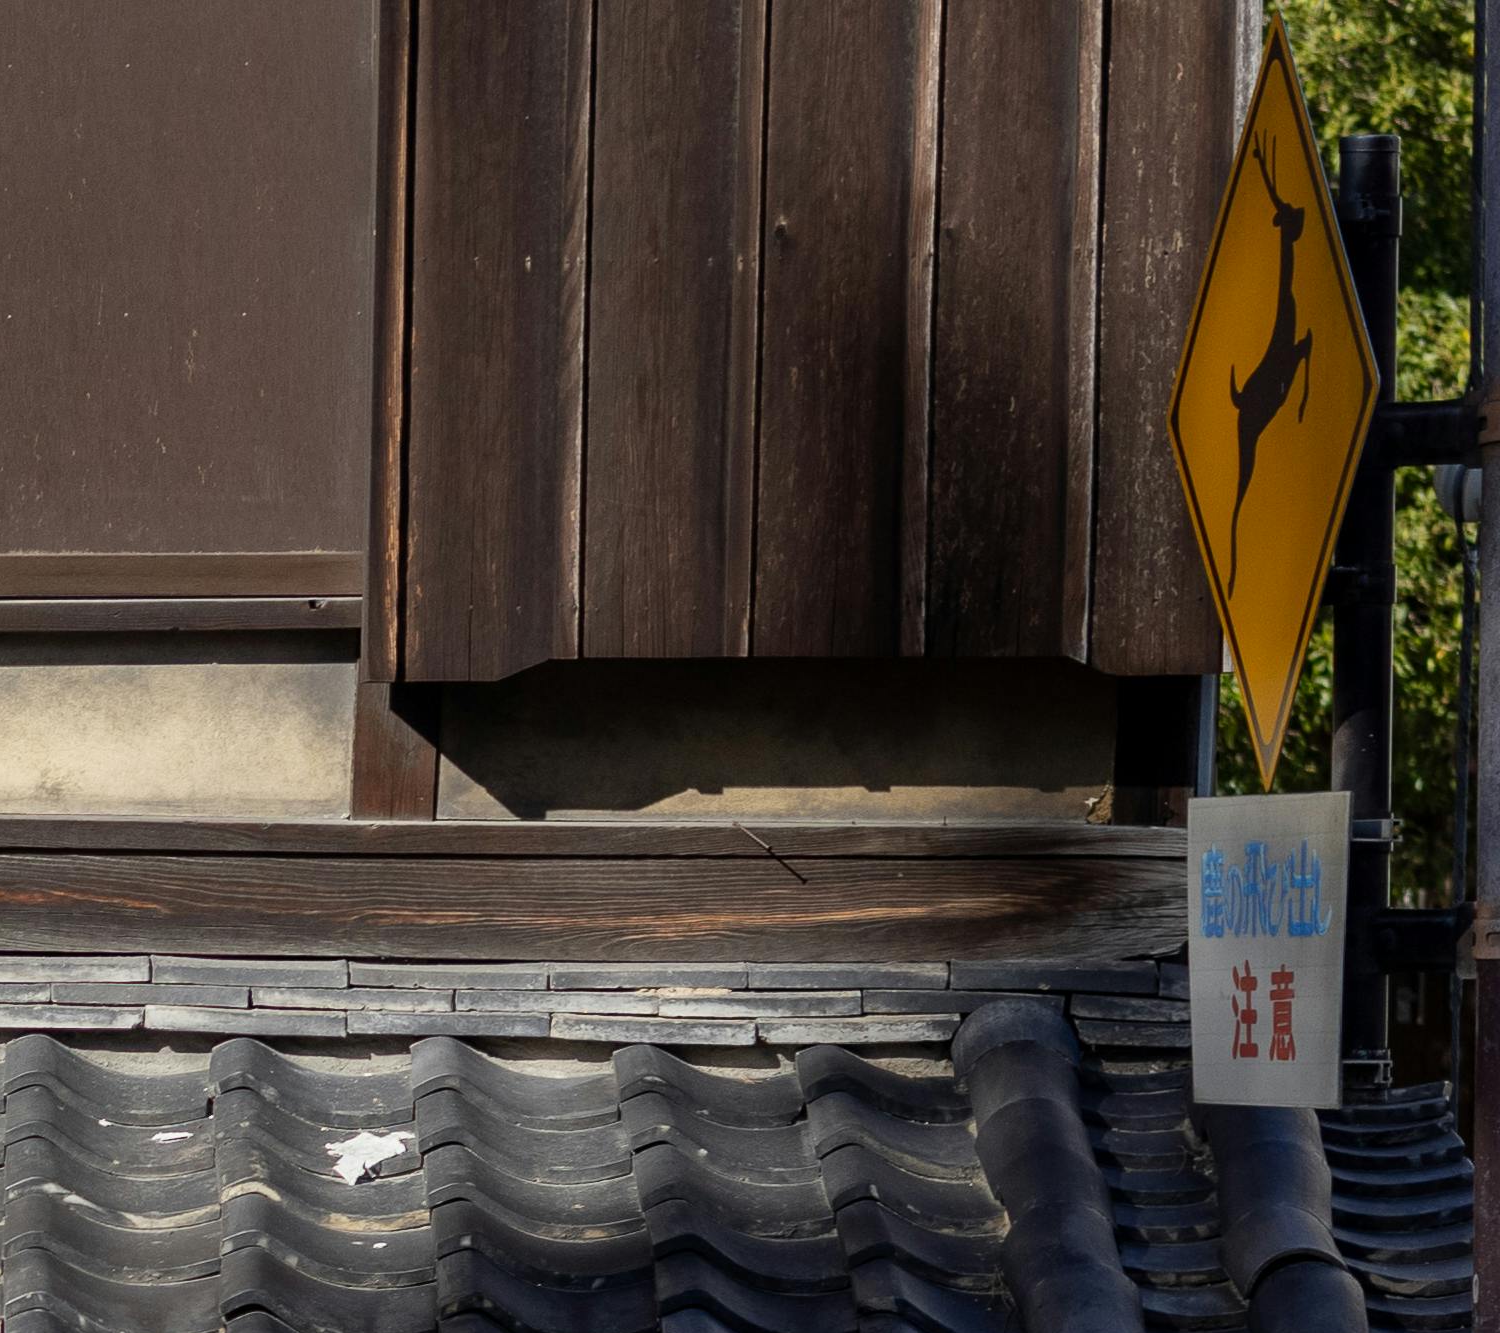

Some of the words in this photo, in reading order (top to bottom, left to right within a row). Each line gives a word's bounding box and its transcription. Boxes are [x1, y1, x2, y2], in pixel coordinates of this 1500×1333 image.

[1202, 840, 1332, 941] 鹿の飛び出し
[1231, 961, 1297, 1063] 注意
